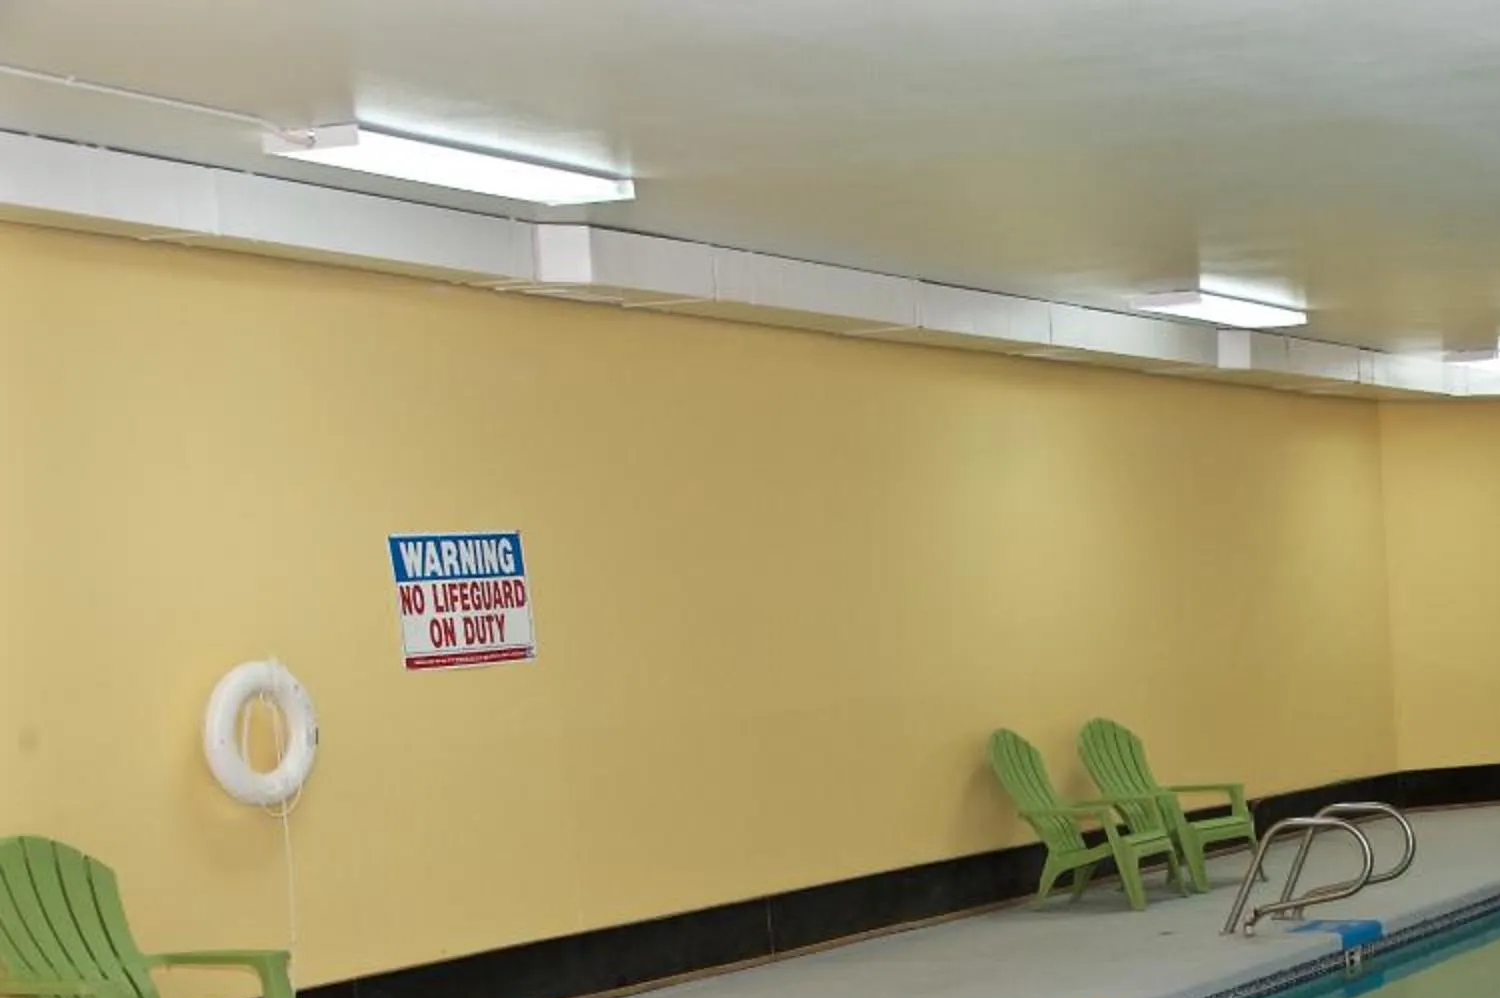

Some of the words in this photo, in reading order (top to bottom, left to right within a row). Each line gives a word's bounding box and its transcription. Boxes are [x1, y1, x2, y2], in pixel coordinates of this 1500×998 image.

[399, 537, 516, 579] WARNING
[400, 583, 425, 616] NO
[431, 579, 526, 613] LIFEGUARD
[429, 617, 457, 648] ON
[463, 613, 505, 645] DUTY
